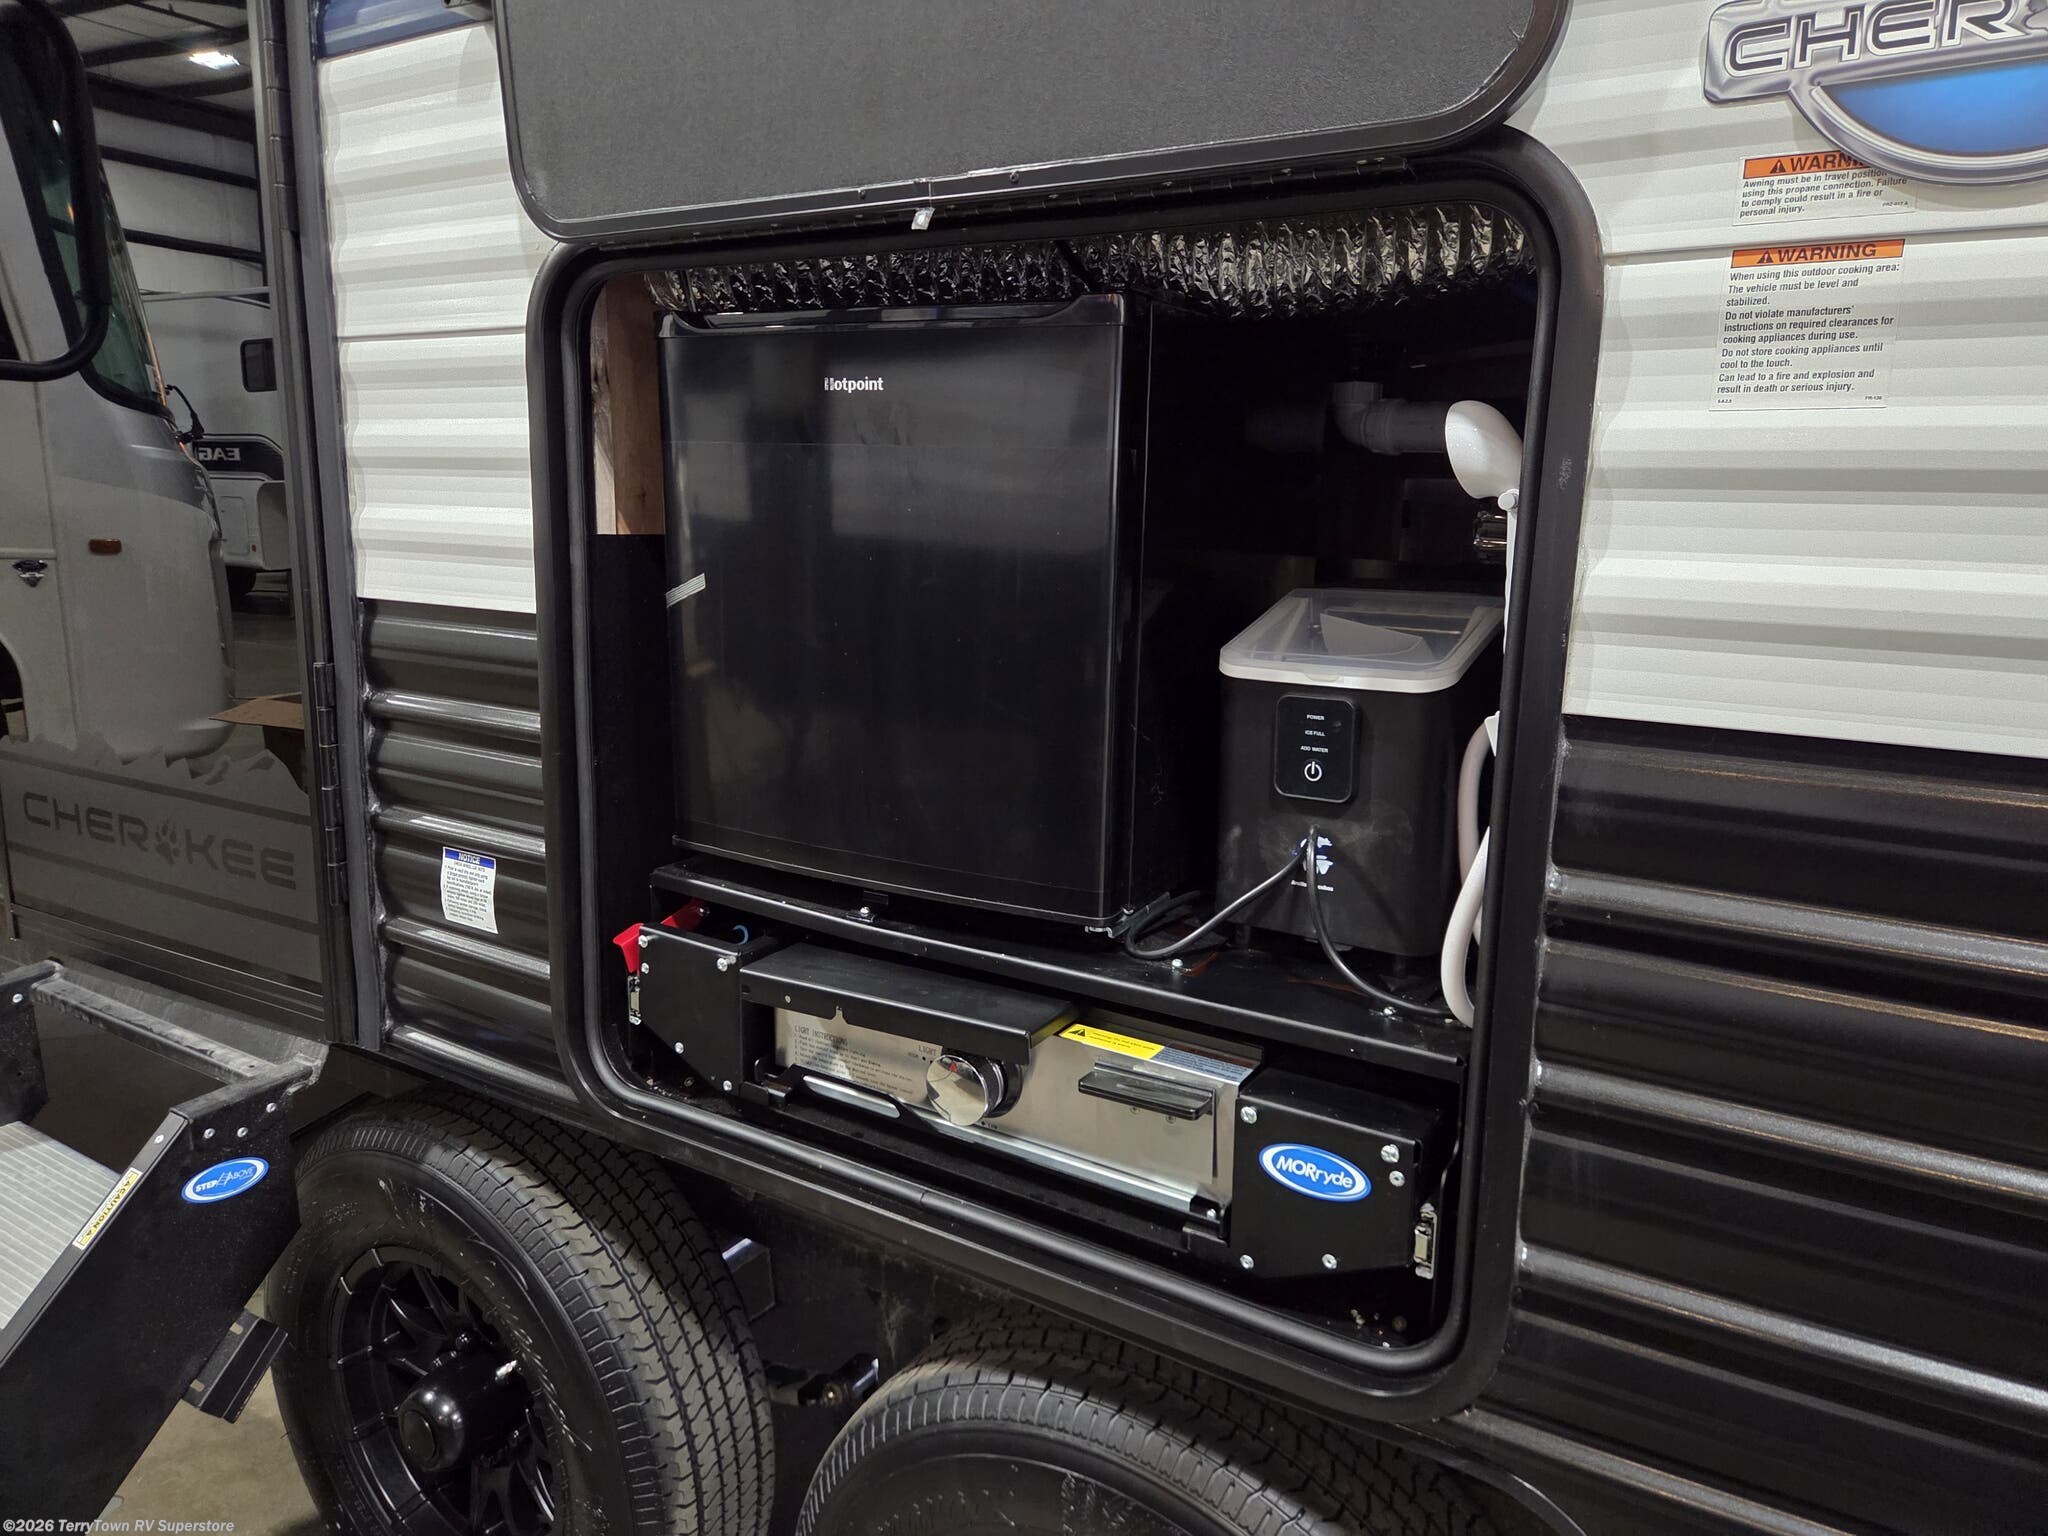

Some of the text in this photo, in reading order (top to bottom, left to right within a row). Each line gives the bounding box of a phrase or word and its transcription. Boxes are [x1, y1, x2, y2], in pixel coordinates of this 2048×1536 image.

[1790, 152, 1865, 172] WARN
[1742, 177, 1908, 198] using this propane connection. Failure
[1743, 180, 1775, 188] Awning
[1777, 177, 1799, 185] must
[1801, 175, 1811, 183] be
[1814, 174, 1822, 182] in
[1825, 171, 1850, 181] travel
[1741, 200, 1750, 208] to
[1752, 197, 1782, 207] comply
[1784, 194, 1808, 204] could
[1810, 191, 1835, 201] result
[1837, 190, 1846, 199] in
[1856, 189, 1871, 198] fire
[1873, 189, 1884, 197] or
[1740, 205, 1805, 218] personal injury.
[1778, 243, 1877, 263] WARNING
[1730, 263, 1900, 281] When using this outdoor cooking area:
[1728, 278, 1859, 294] The vehicle must be level and
[1726, 296, 1771, 307] stabilized.
[1725, 311, 1737, 321] Do
[1739, 310, 1753, 320] not
[1755, 308, 1785, 318] violate
[1724, 315, 1895, 332] instructions on required clearances for
[1722, 330, 1858, 345] cooking appliances during use.
[1721, 342, 1883, 357] Do not store cooking appliances until
[1720, 358, 1793, 369] cool to the touch.
[1718, 373, 1735, 382] Can
[1737, 372, 1756, 382] lead
[1758, 372, 1766, 381] to
[1776, 371, 1791, 380] fire
[1793, 370, 1810, 380] and
[1812, 369, 1855, 381] explosion
[1857, 368, 1875, 378] and
[824, 376, 884, 393] Hotpoint
[1717, 381, 1854, 394] result in death or serious injury.
[458, 852, 481, 865] NOTICE
[1276, 1155, 1354, 1188] MORryde
[93, 1188, 126, 1229] CAUTION
